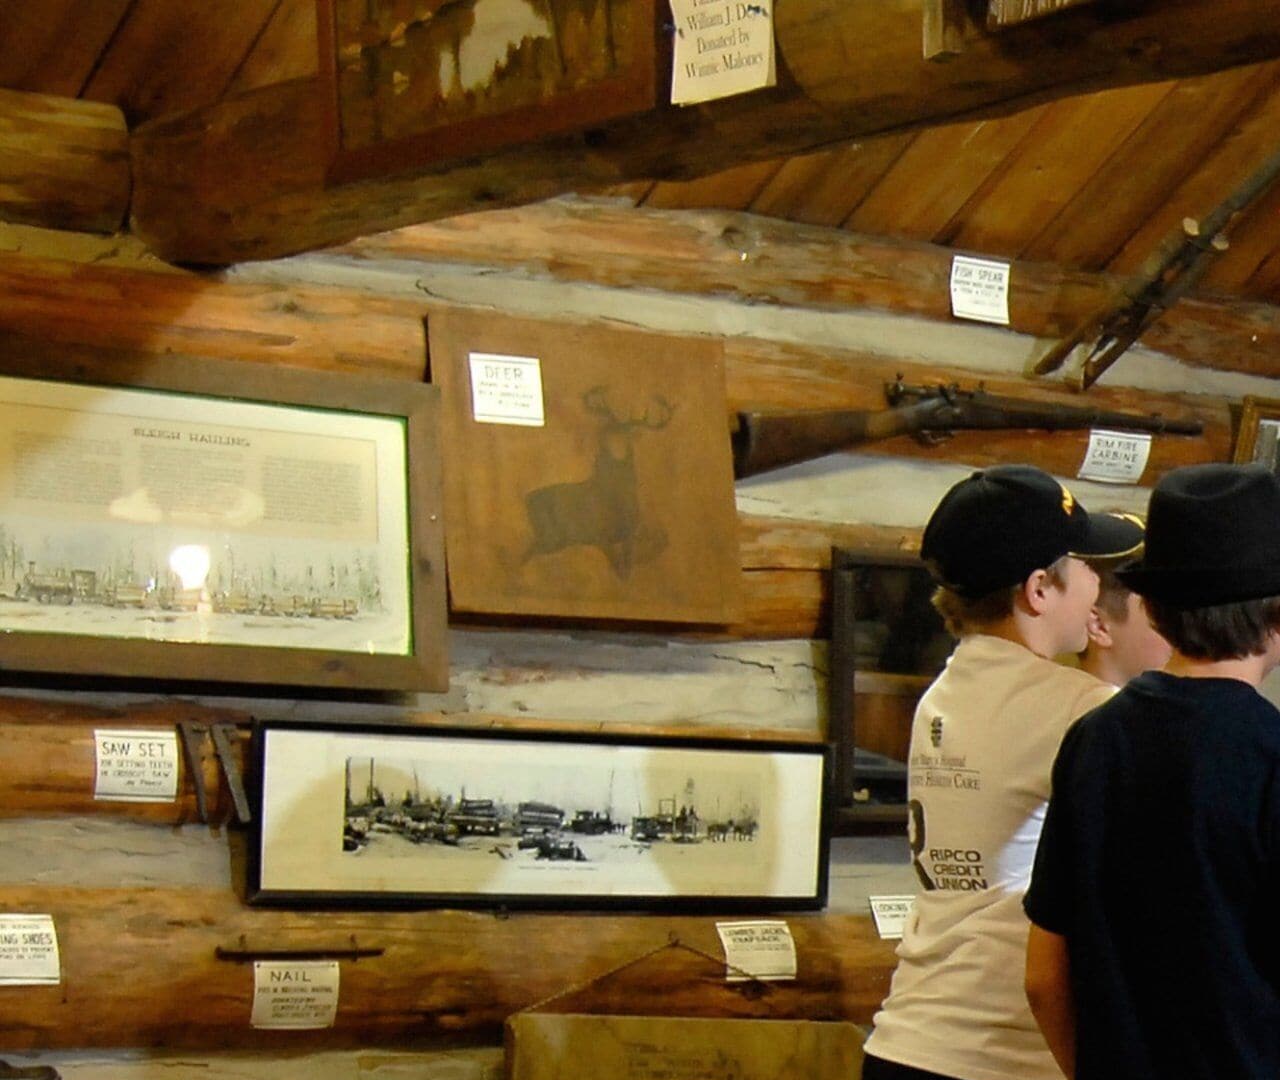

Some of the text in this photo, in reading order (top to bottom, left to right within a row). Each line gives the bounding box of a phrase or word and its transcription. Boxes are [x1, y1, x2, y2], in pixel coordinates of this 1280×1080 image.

[697, 28, 736, 54] Donated
[102, 741, 165, 757] SAW SET
[930, 849, 981, 863] RIPCO
[934, 864, 984, 877] CREDIT
[936, 877, 988, 891] UNION
[0, 933, 18, 945] ING
[270, 971, 311, 983] NAIL
